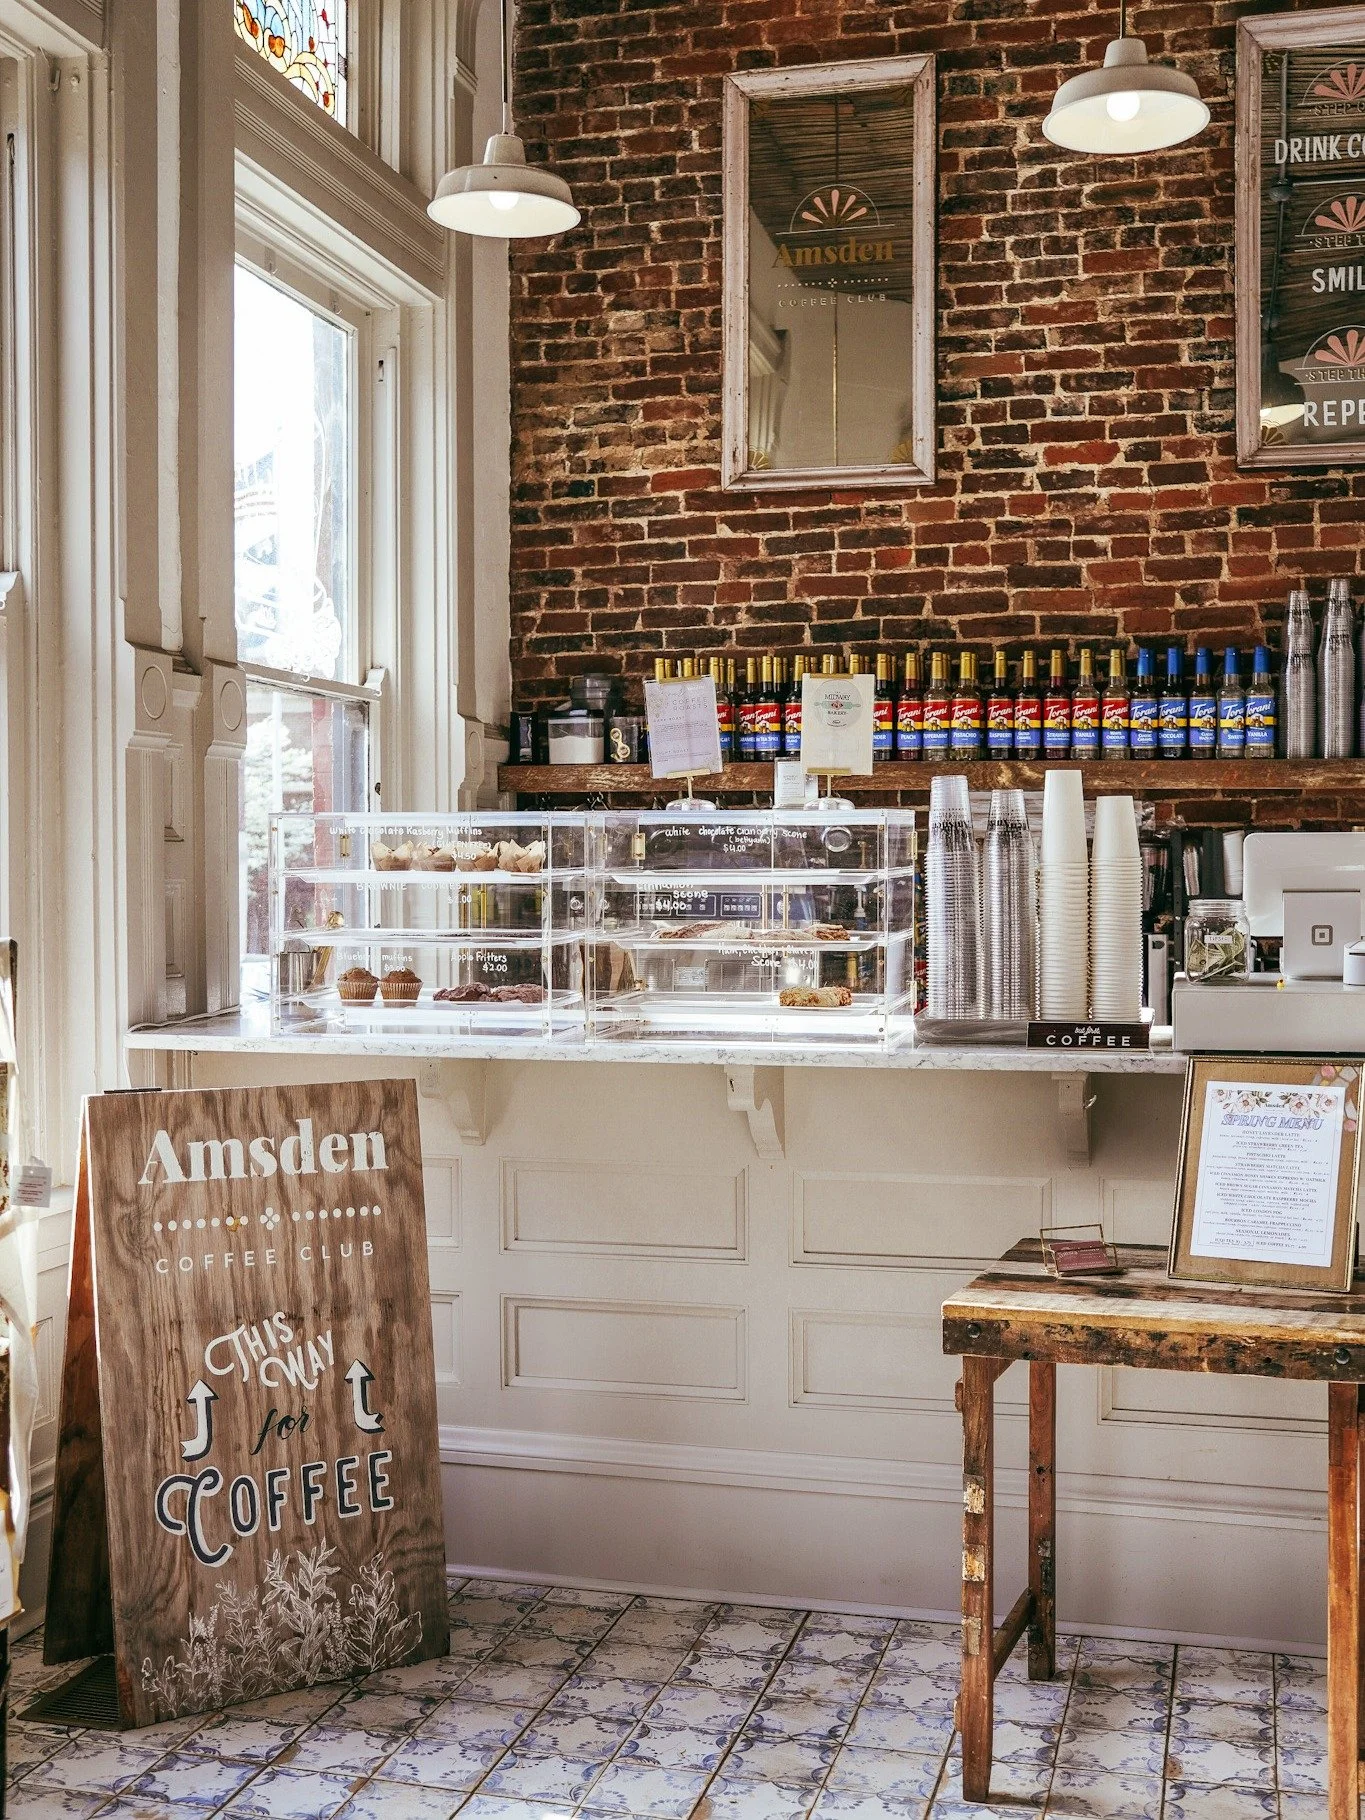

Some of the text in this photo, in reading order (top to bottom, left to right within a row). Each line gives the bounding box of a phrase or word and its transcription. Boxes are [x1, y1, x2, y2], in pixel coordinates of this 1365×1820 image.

[1275, 133, 1365, 164] DRINK C
[772, 237, 894, 268] Amsden
[1312, 266, 1365, 293] SMIL
[779, 293, 886, 307] COFFEE CLUB
[1308, 370, 1344, 382] STEP
[755, 708, 778, 722] Torani
[897, 706, 921, 722] Torani
[923, 706, 948, 722] Torani
[952, 705, 979, 721] Torani
[988, 705, 1013, 721] Torani
[1014, 705, 1038, 722] Torani
[1046, 705, 1070, 721] Toran
[1072, 704, 1098, 721] Torani
[1103, 704, 1128, 721] Torani
[1131, 704, 1157, 721] Torani
[1159, 703, 1185, 720] Torani
[1192, 703, 1216, 720] Toran
[1246, 701, 1272, 718] Torani
[329, 826, 356, 835] White
[446, 826, 482, 836] Muffins
[665, 826, 691, 837] white
[698, 825, 735, 838] chocolate
[781, 830, 808, 839] scone
[451, 851, 477, 861] $4.50
[722, 843, 746, 853] $4.00
[356, 882, 408, 891] BRWNIE
[655, 899, 687, 911] $4.00
[475, 951, 508, 962] Fritters
[482, 963, 509, 973] $2.00
[1046, 1035, 1131, 1046] COFFEE
[1221, 1114, 1324, 1130] SPRING MENU
[138, 1117, 389, 1186] Amsden
[155, 1240, 375, 1275] COFFEE CLUB
[204, 1311, 296, 1383] THIS
[259, 1330, 335, 1391] WAY
[249, 1404, 315, 1456] for
[154, 1449, 395, 1568] COFFEE
